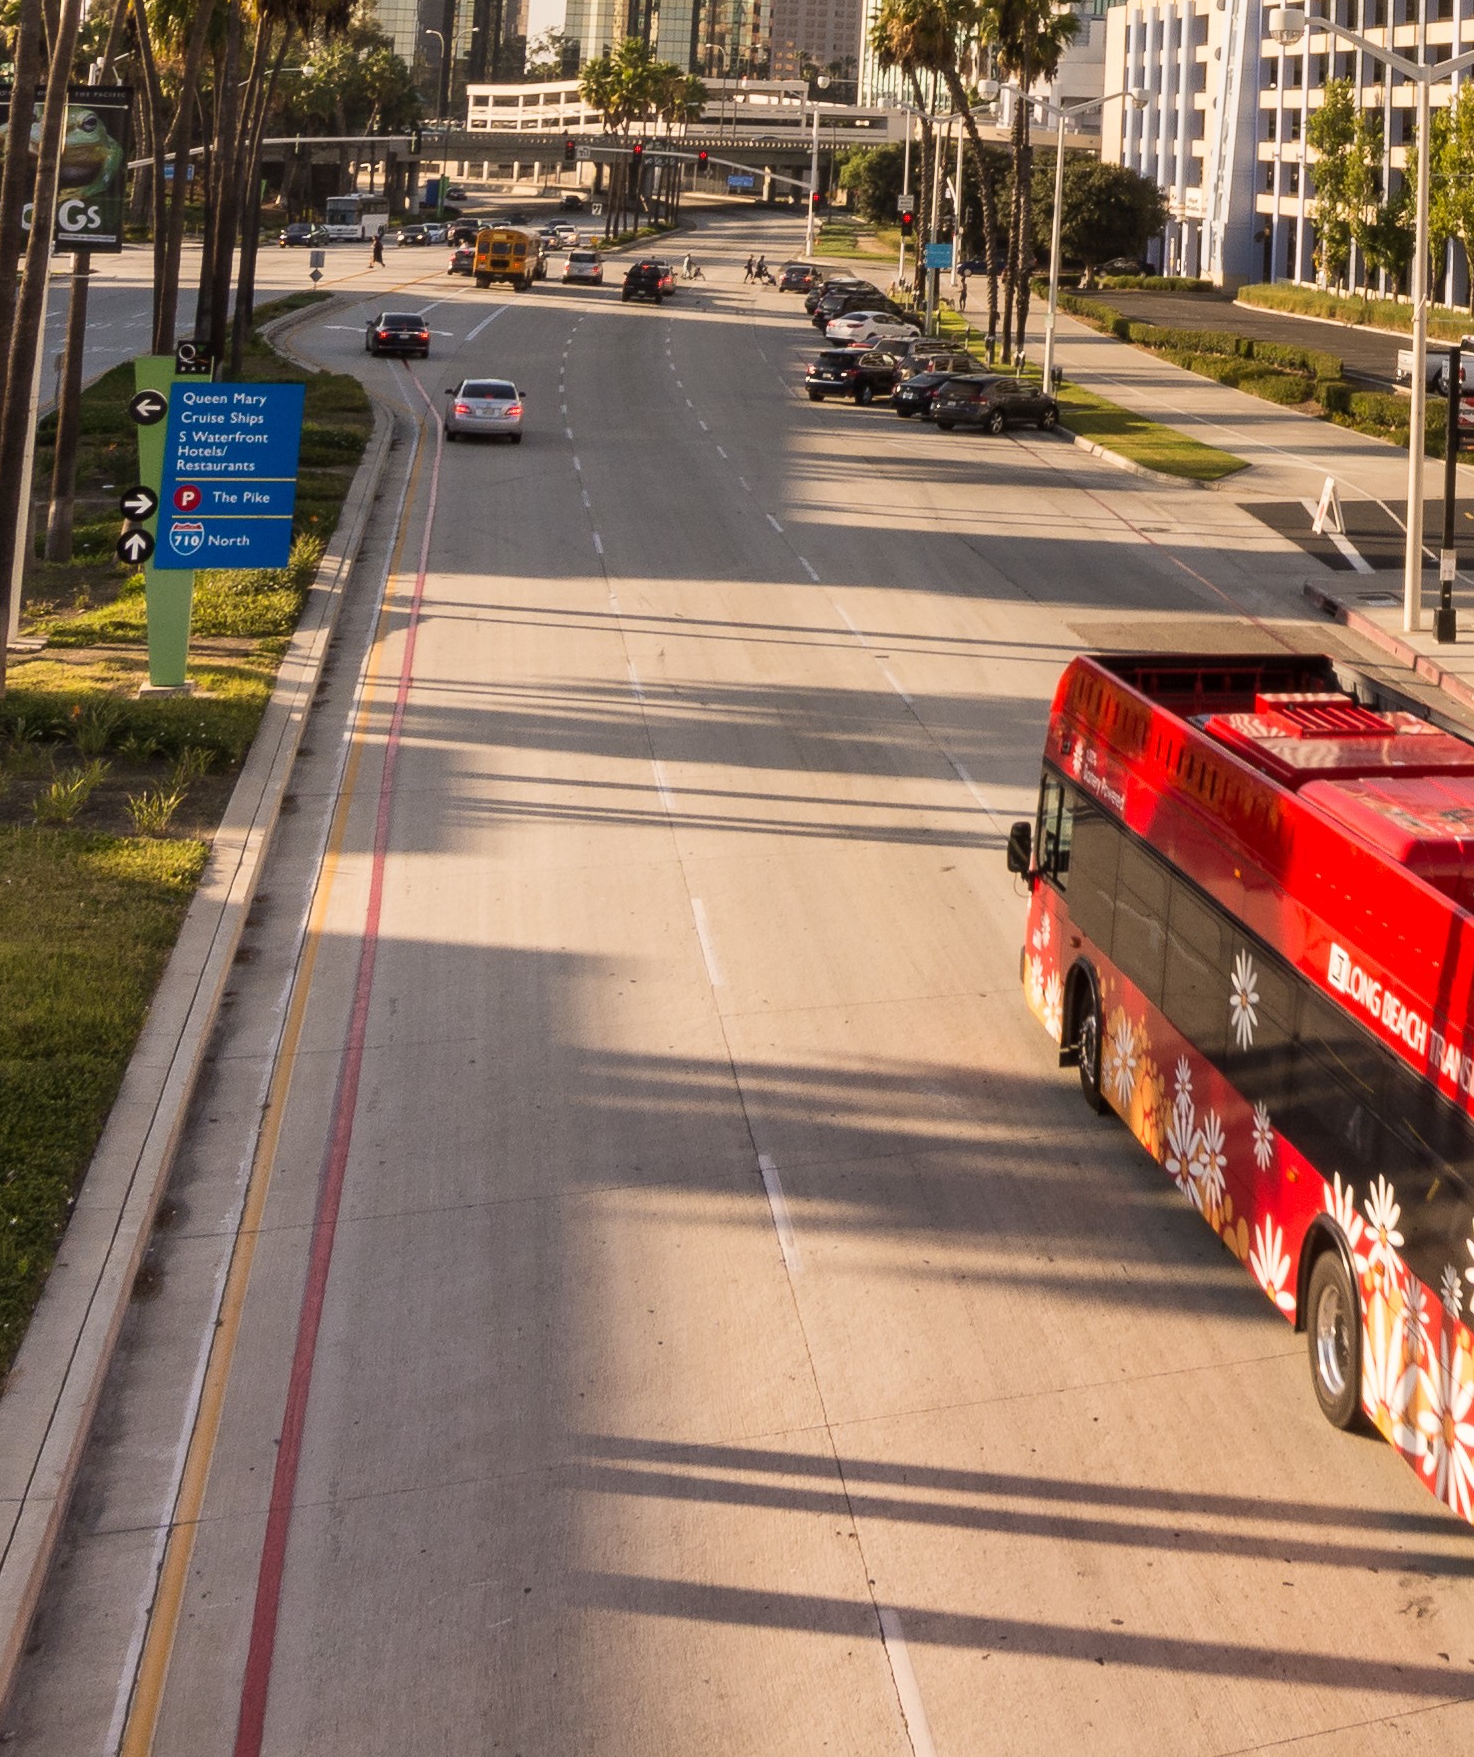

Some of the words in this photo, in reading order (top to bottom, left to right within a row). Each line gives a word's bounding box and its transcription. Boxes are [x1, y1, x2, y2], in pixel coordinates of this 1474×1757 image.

[183, 392, 227, 405] Queen
[233, 393, 267, 407] Mary
[181, 411, 225, 424] Cruise
[230, 412, 264, 426] Ships
[179, 431, 186, 442] S
[192, 431, 268, 443] Waterfront
[177, 445, 228, 457] Hotels/
[176, 459, 255, 471] Restaurants
[182, 491, 195, 506] P
[213, 491, 237, 503] The
[243, 491, 270, 503] Pike
[174, 535, 200, 547] 710
[208, 535, 250, 546] North
[1344, 959, 1382, 1018] LONG
[1381, 990, 1427, 1056] BEACH
